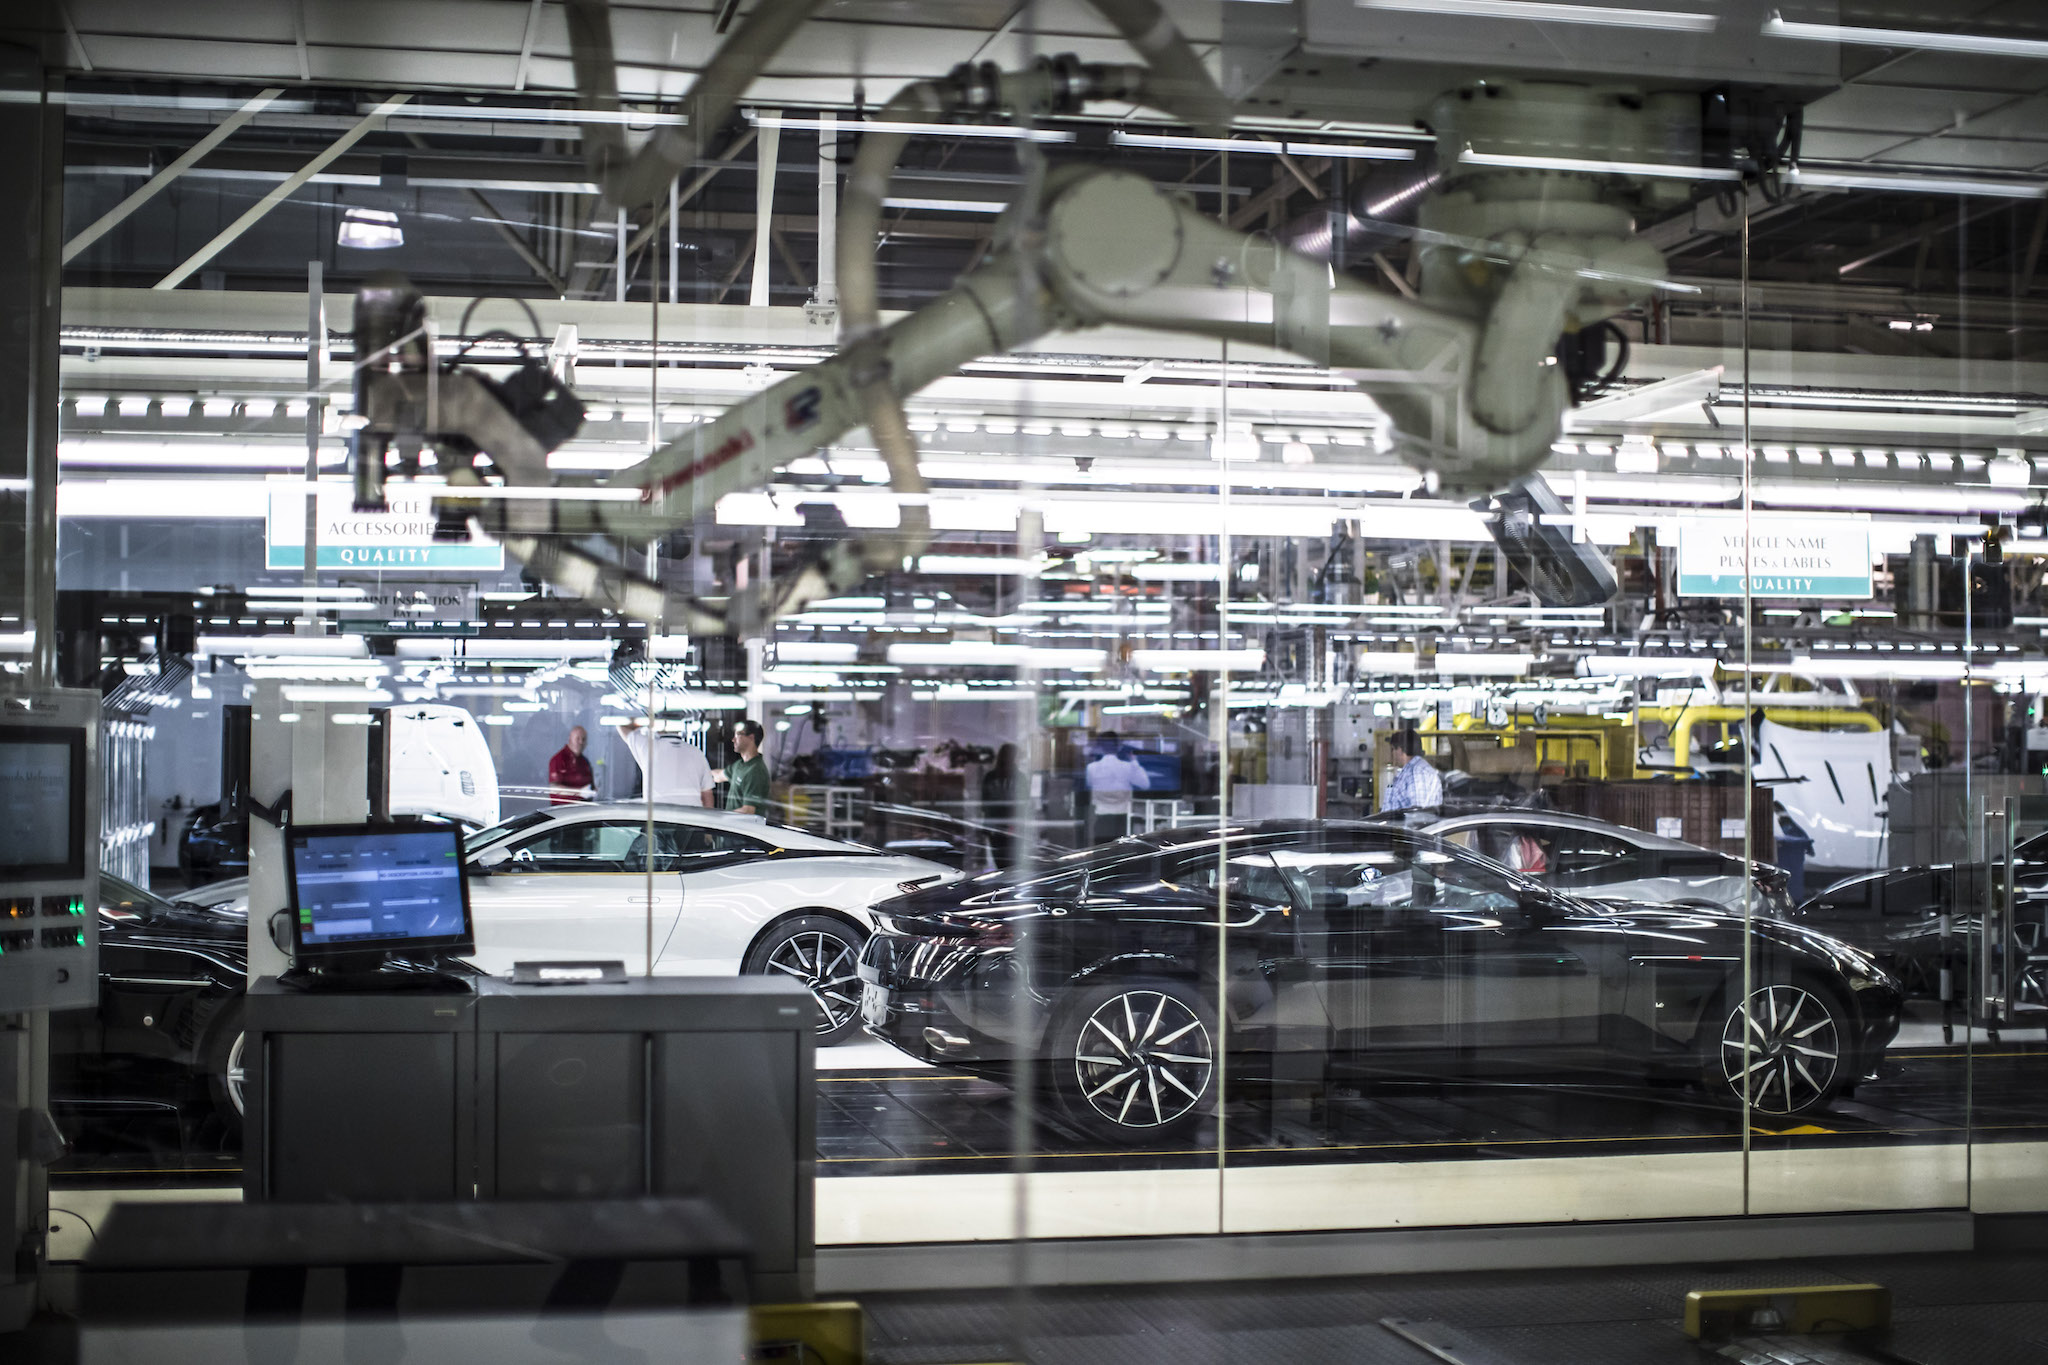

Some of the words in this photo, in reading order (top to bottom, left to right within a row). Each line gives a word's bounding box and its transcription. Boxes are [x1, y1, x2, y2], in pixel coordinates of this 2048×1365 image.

[328, 522, 440, 536] ACCESSORIE
[1786, 537, 1826, 549] NAME
[340, 549, 430, 564] QUALITY
[1720, 556, 1767, 567] PLAES
[1783, 557, 1831, 568] LABELS
